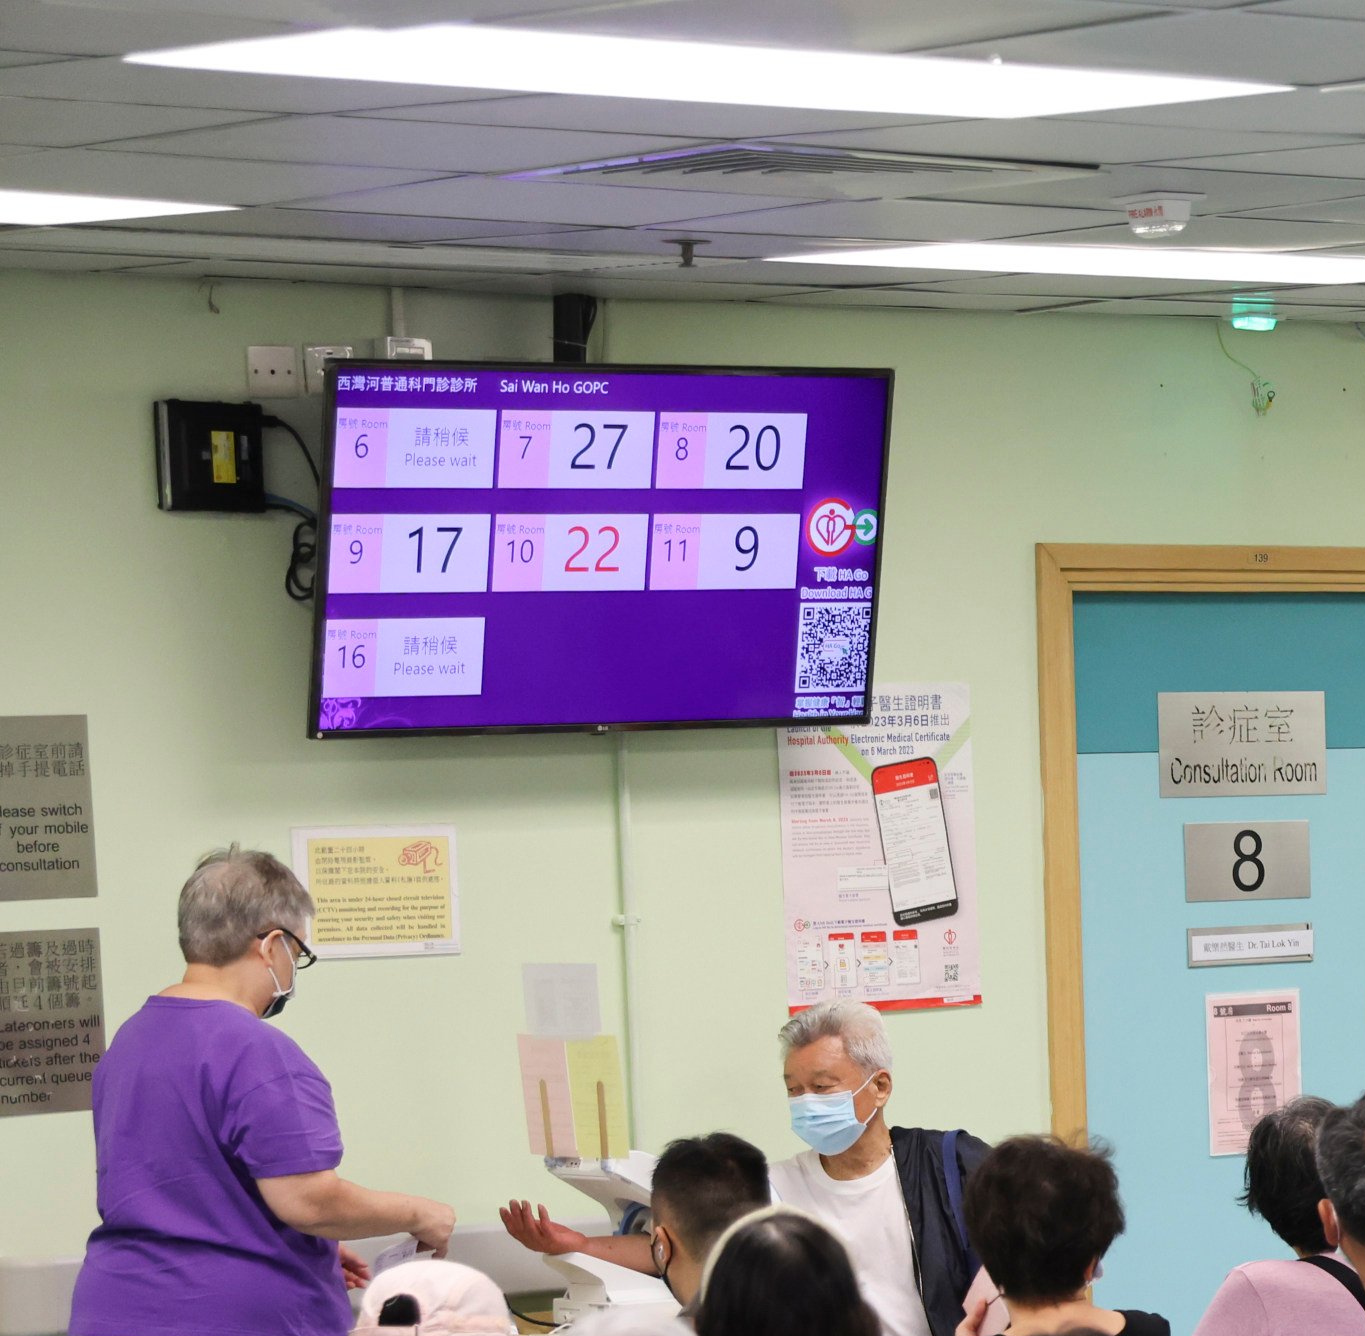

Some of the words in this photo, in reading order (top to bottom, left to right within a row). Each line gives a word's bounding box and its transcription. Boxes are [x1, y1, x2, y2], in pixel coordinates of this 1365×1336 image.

[337, 375, 478, 393] 西灣河普通科門診診所
[500, 379, 518, 394] Sai
[522, 380, 549, 394] Wan
[552, 381, 570, 394] Ho
[573, 381, 609, 395] GOPC
[361, 419, 388, 429] Room
[525, 421, 552, 432] Room
[682, 422, 707, 432] Room
[414, 427, 470, 447] 請稍候
[354, 434, 369, 459] 6
[519, 435, 533, 460] 7
[570, 422, 629, 470] 27
[675, 437, 689, 461] 8
[725, 424, 781, 471] 20
[404, 453, 446, 468] Please
[449, 454, 477, 467] wait
[355, 524, 383, 535] Room
[519, 524, 545, 535] Room
[675, 524, 701, 534] Room
[349, 539, 364, 564] 9
[408, 526, 463, 574] 17
[506, 539, 534, 563] 10
[564, 525, 621, 573] 22
[663, 539, 689, 563] 11
[734, 525, 760, 571] 9
[1253, 552, 1269, 563] 139
[814, 567, 837, 582] 下載
[838, 569, 854, 581] HA
[854, 568, 869, 582] Go
[801, 586, 848, 600] Download
[849, 587, 863, 600] HA
[350, 629, 377, 640] Room
[403, 635, 458, 656] 請稍候
[338, 644, 366, 669] 16
[393, 662, 435, 676] Please
[438, 661, 466, 674] wait
[1191, 704, 1295, 745] 診症室
[787, 736, 816, 748] Hospital
[817, 735, 849, 747] Authority
[850, 733, 885, 744] Electronic
[886, 732, 914, 743] Medical
[914, 731, 950, 743] Certificate
[876, 746, 897, 756] March
[898, 745, 915, 756] 2023
[1170, 755, 1267, 786] Consultation
[1273, 755, 1318, 783] Room
[41, 803, 83, 817] switch
[9, 825, 39, 839] your
[44, 822, 89, 835] mobile
[16, 840, 60, 854] before
[0, 858, 80, 872] consultation
[1231, 829, 1266, 893] 8
[1247, 941, 1259, 950] Dr.
[1259, 940, 1271, 949] Tai
[1272, 939, 1286, 948] Lok
[1287, 938, 1300, 947] Yin
[1266, 1004, 1286, 1013] Room
[79, 1014, 100, 1029] will
[19, 1035, 79, 1052] assigned
[82, 1033, 91, 1046] 4
[45, 1053, 76, 1066] after
[80, 1052, 100, 1064] the
[0, 1074, 47, 1087] current
[51, 1070, 92, 1086] queue
[1, 1091, 51, 1105] number
